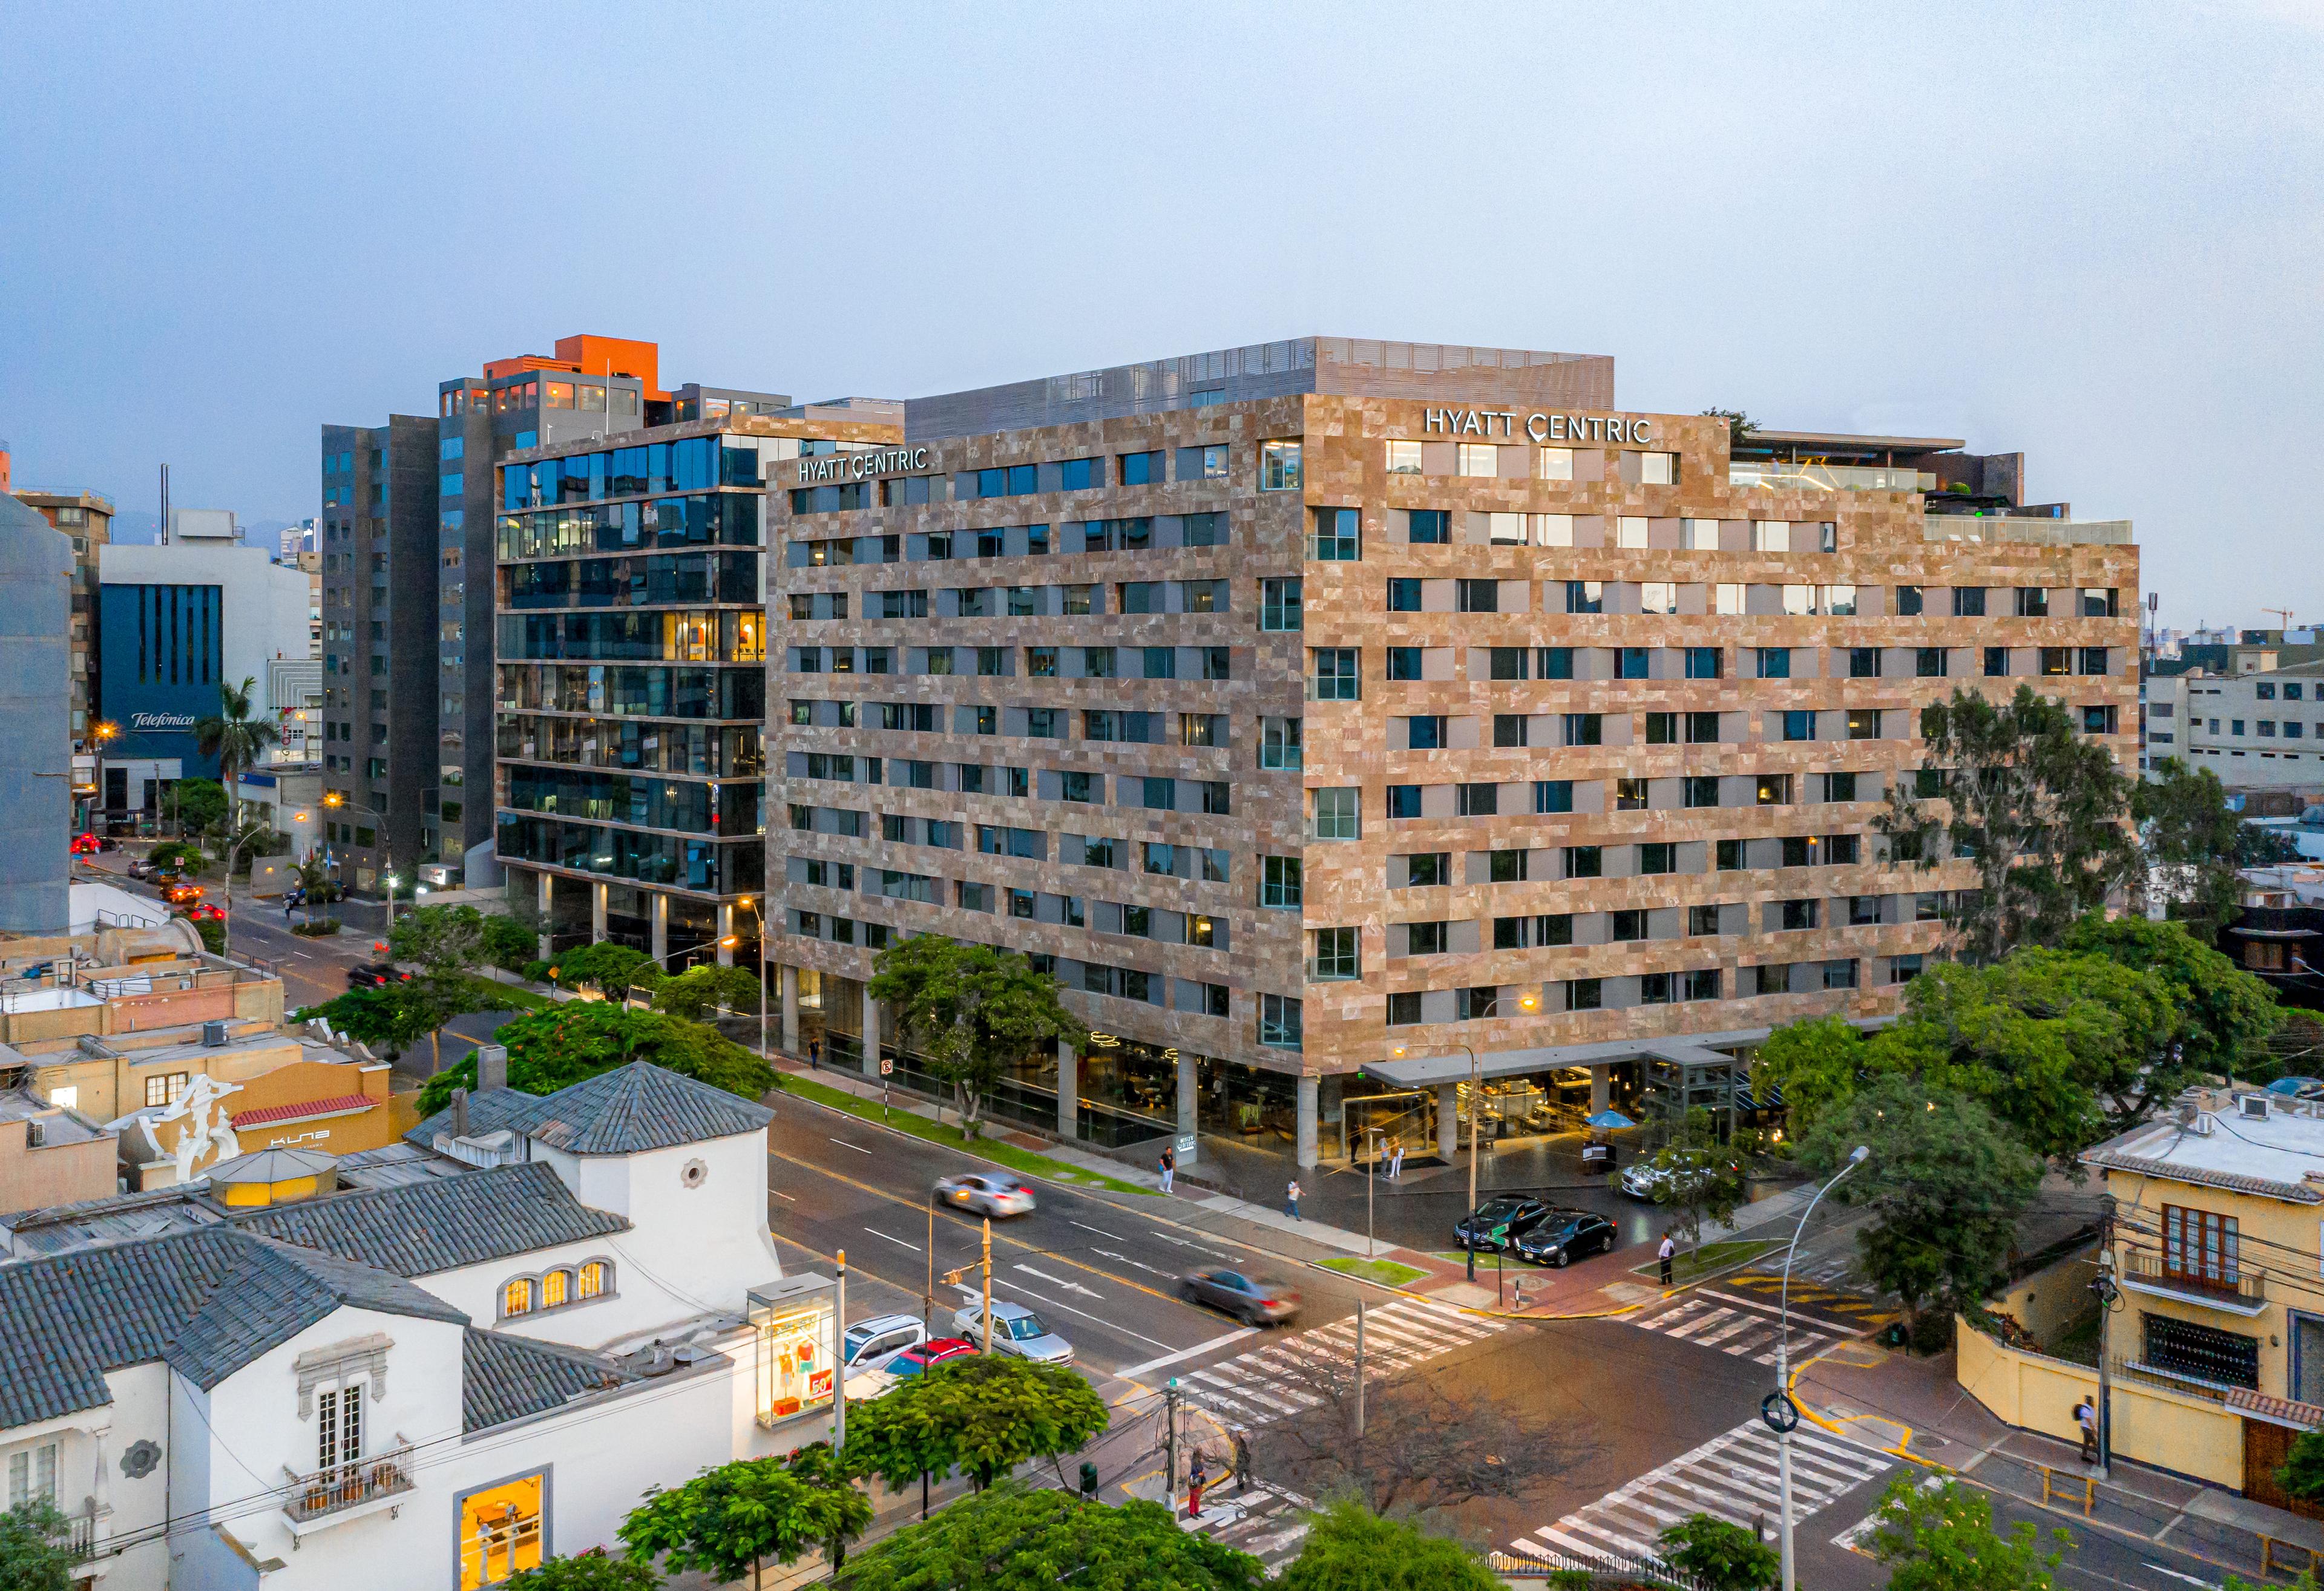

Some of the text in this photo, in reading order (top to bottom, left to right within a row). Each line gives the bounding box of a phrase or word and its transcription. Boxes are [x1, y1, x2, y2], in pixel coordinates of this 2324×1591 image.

[1425, 407, 1651, 444] HYATT CENTRIC
[799, 447, 927, 482] HYATT CENTRIC
